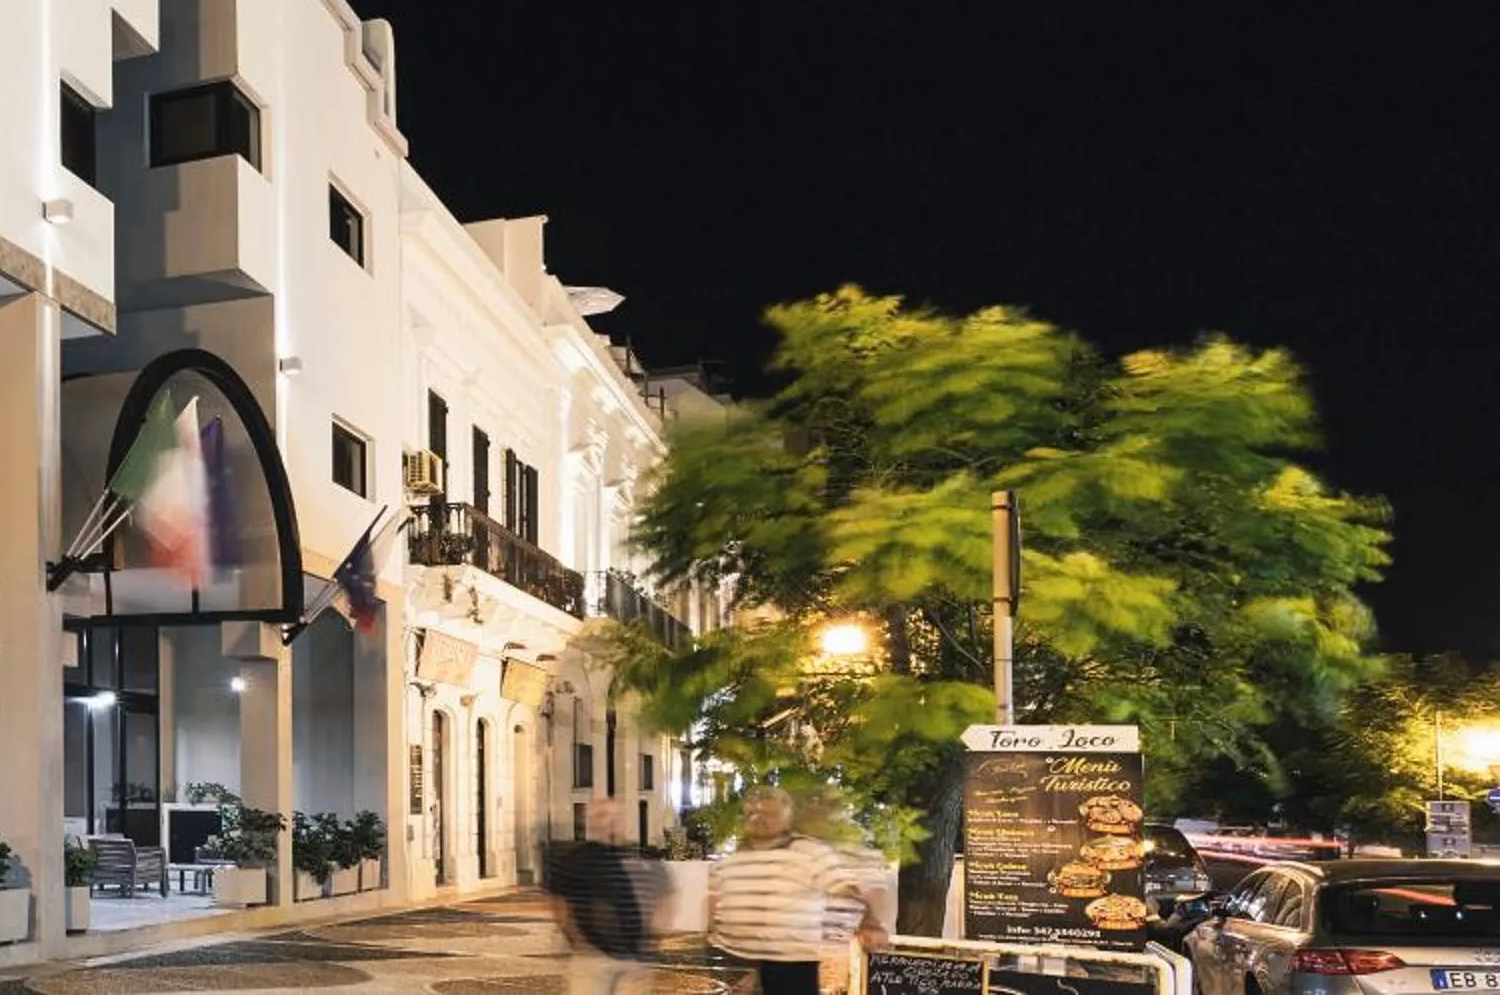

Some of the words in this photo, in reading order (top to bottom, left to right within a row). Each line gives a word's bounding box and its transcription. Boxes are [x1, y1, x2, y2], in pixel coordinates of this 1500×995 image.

[989, 730, 1041, 748] Toro
[1058, 728, 1116, 749] Loco
[1040, 774, 1132, 793] Turistico
[1450, 972, 1477, 988] EB
